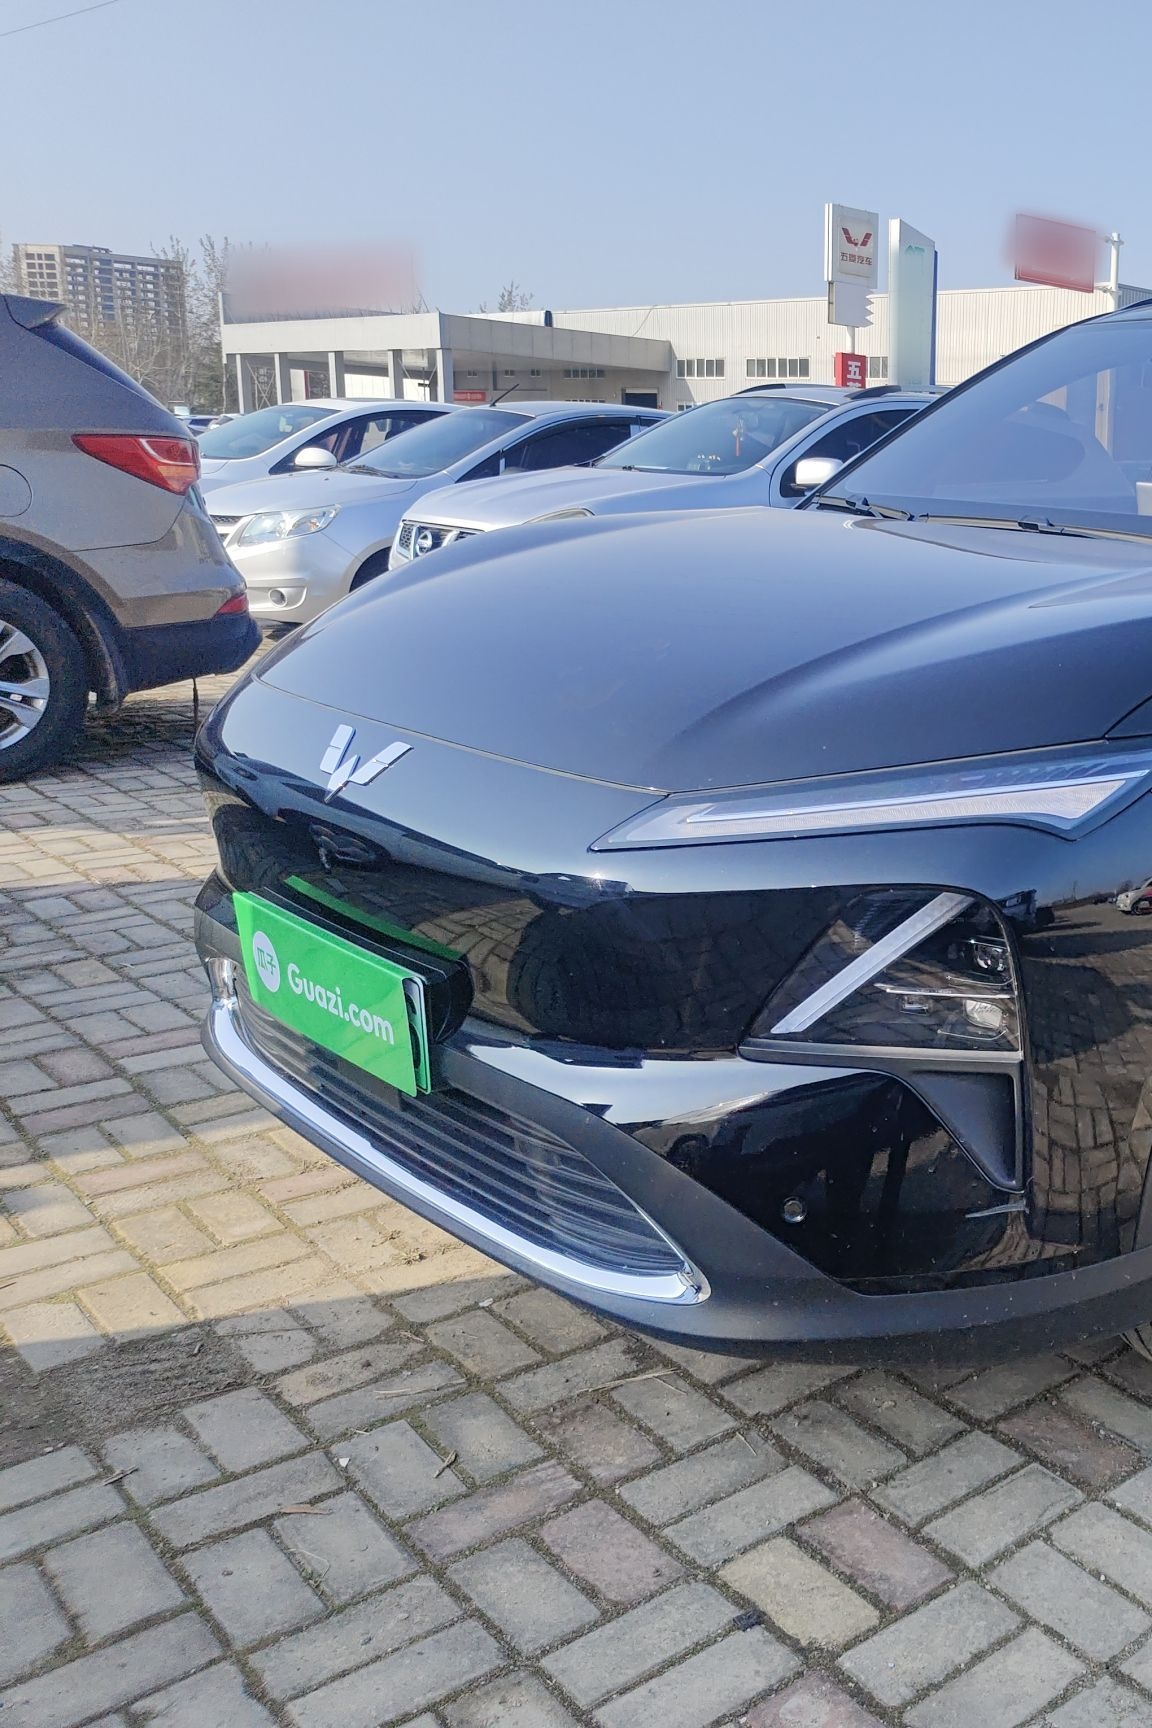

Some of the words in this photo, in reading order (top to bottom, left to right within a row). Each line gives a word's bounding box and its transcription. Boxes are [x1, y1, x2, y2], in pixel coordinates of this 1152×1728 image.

[840, 252, 872, 266] 五菱汽车
[256, 946, 276, 976] 瓜子
[287, 963, 395, 1045] Guazi.com
